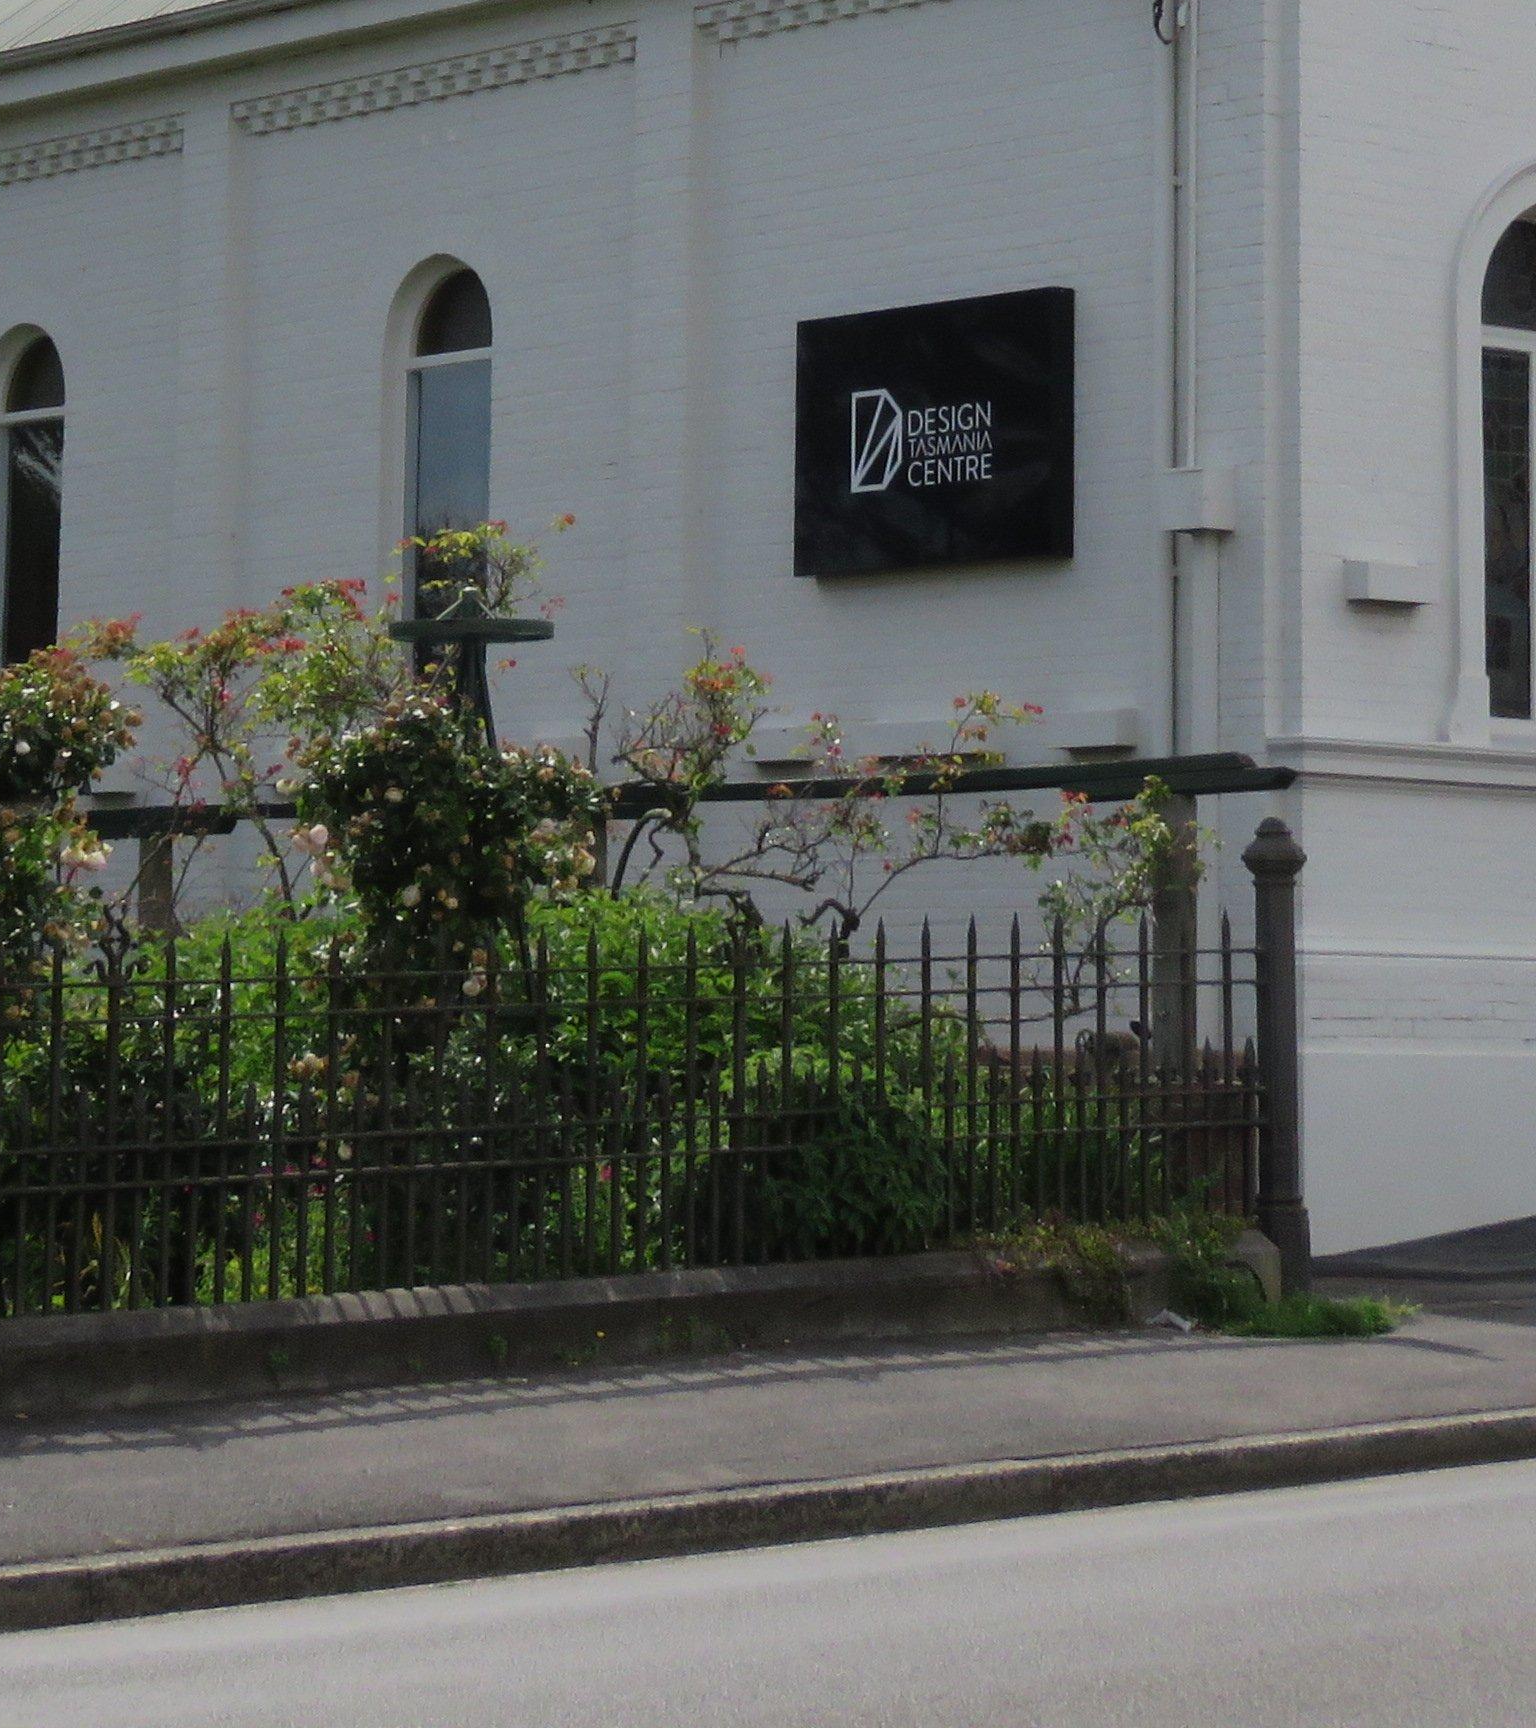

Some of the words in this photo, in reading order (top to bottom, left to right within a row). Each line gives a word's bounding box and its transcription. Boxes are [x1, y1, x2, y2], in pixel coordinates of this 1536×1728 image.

[907, 401, 991, 436] DESIGN
[907, 431, 993, 457] TASMANIA
[907, 453, 993, 486] CENTRE
